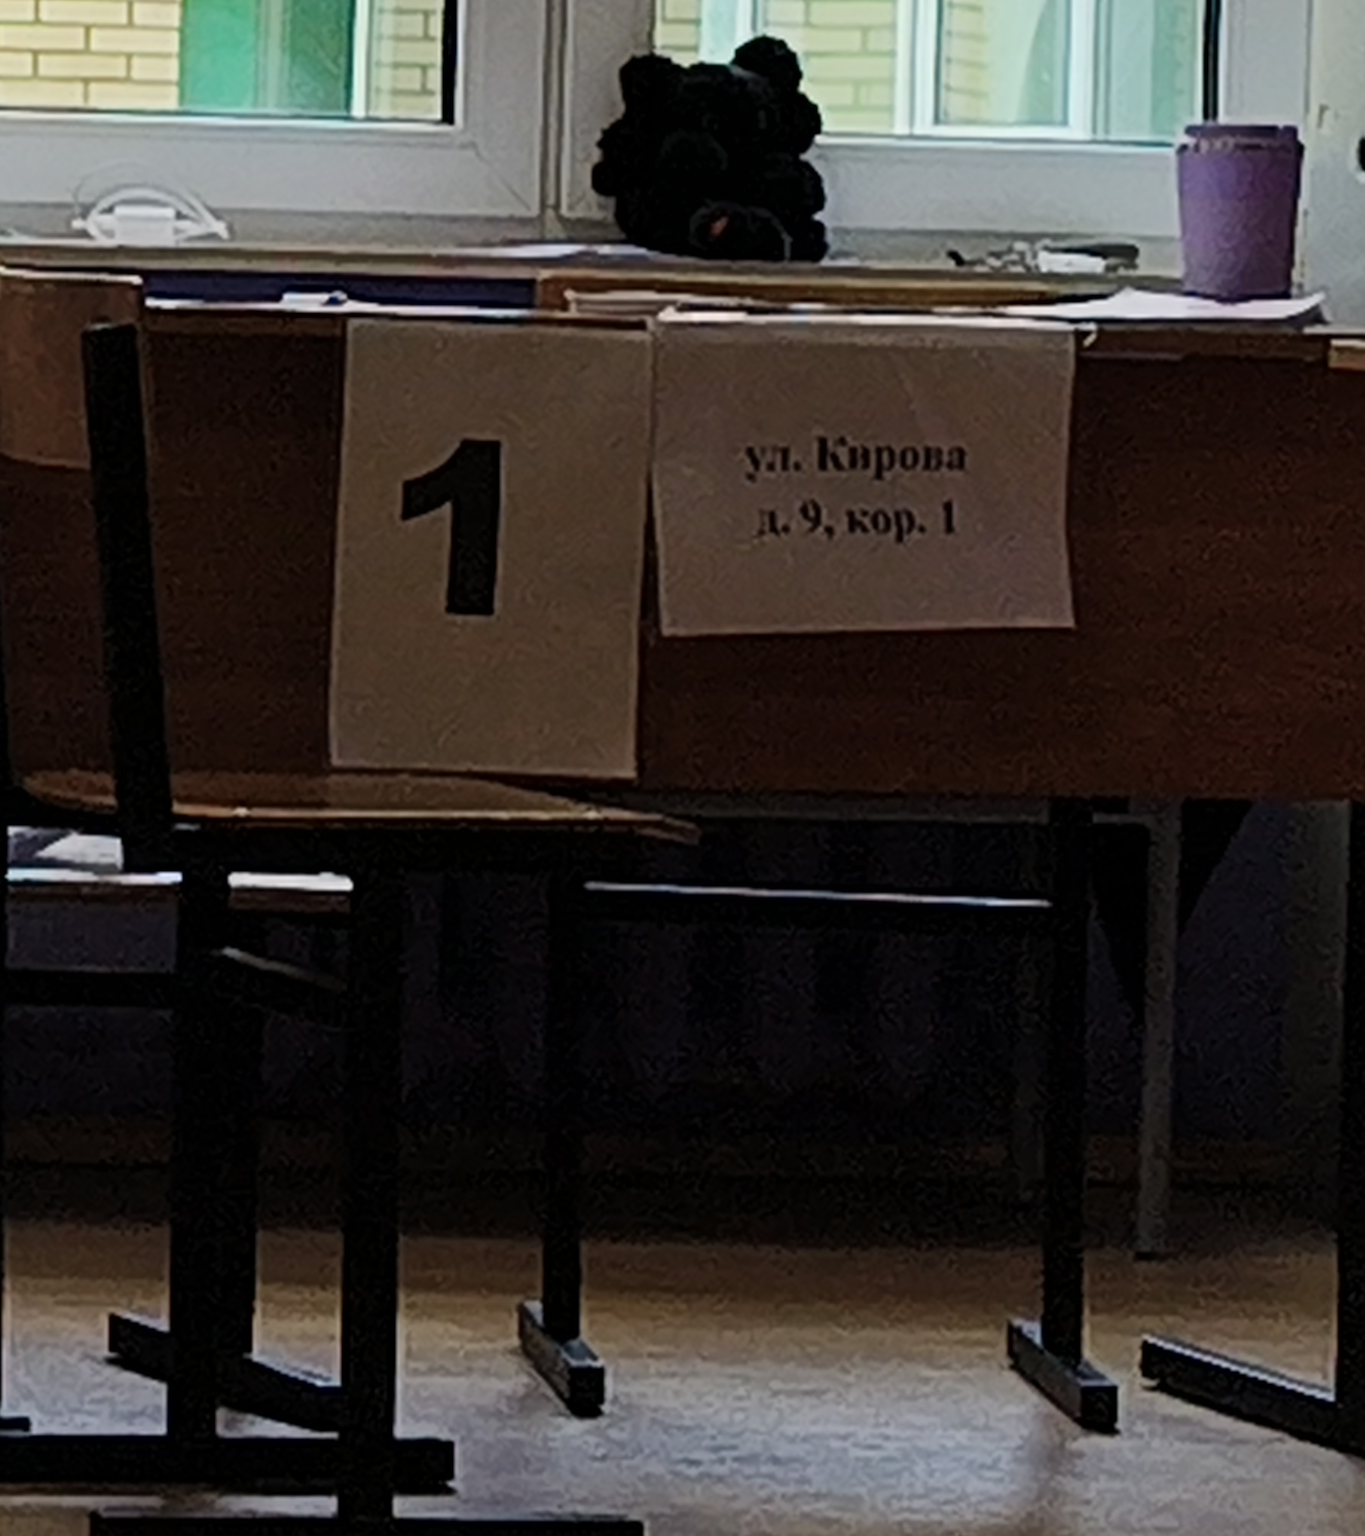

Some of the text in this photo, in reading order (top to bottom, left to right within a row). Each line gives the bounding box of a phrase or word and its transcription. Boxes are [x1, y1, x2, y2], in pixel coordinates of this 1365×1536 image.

[744, 435, 967, 482] ул. Кирова
[400, 437, 501, 615] 1
[753, 498, 956, 543] д. 9, кор. 1
